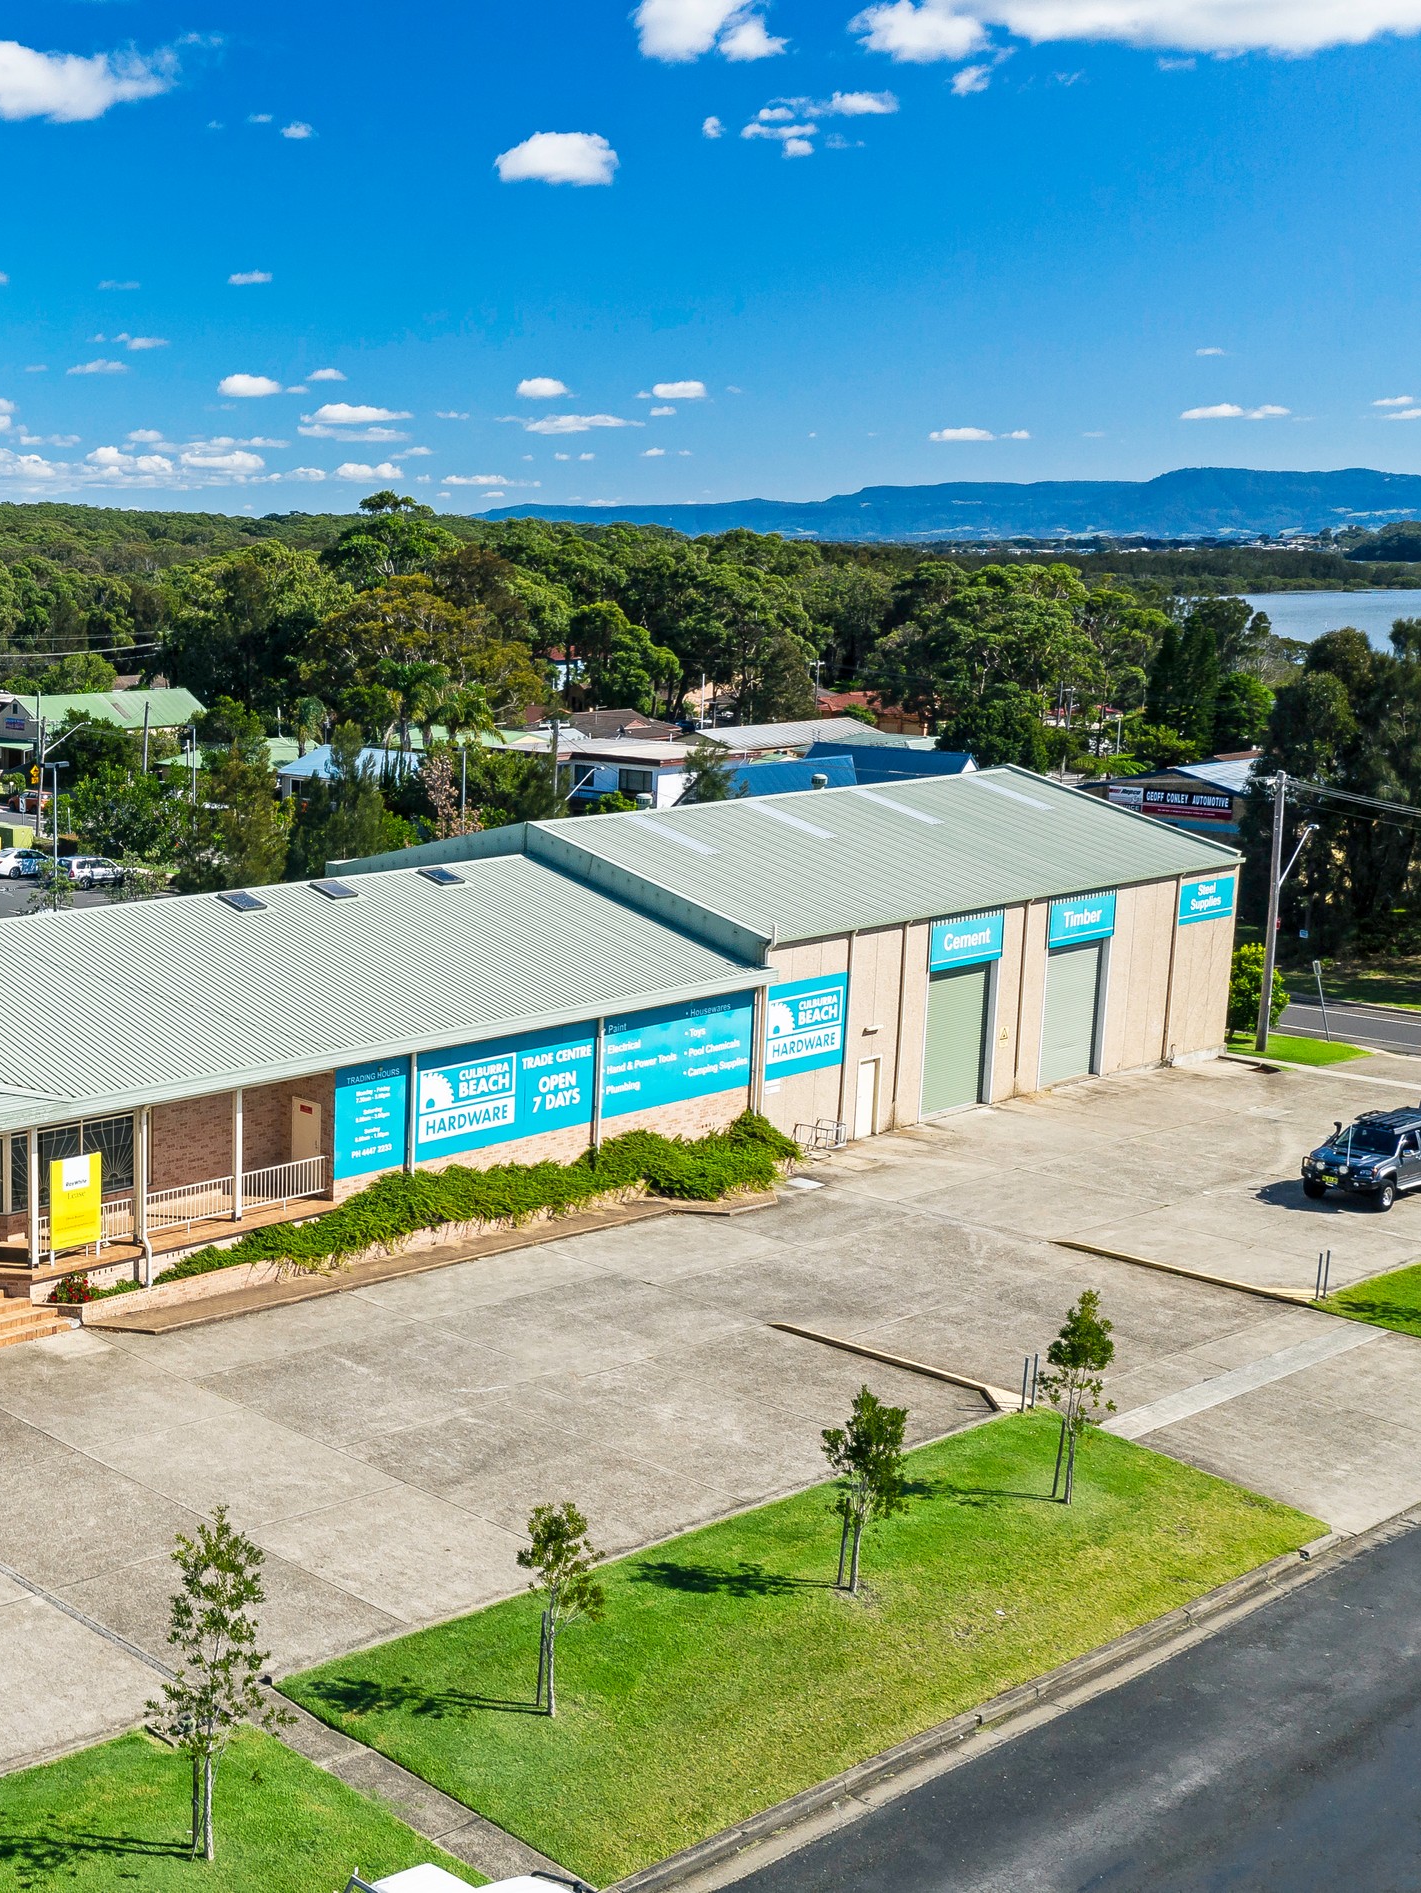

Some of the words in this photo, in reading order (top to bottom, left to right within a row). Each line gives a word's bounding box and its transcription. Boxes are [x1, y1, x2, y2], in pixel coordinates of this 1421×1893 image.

[1146, 791, 1164, 802] GEOFF
[1166, 793, 1188, 804] CONLEY
[1191, 794, 1229, 808] AUTOMOTIVE
[1198, 882, 1216, 896] Steel
[1190, 895, 1222, 911] Supplies
[1063, 908, 1102, 928] Timber
[943, 927, 991, 951] Cement
[690, 1003, 731, 1017] Housewares
[798, 994, 838, 1010] CULBURRA
[798, 1004, 838, 1026] BEACH
[608, 1023, 627, 1033] Paint
[689, 1028, 706, 1038] Toys
[607, 1039, 641, 1054] Electrical
[688, 1045, 704, 1057] Pool
[705, 1039, 740, 1054] Chemicals
[772, 1032, 836, 1058] HARDWARE
[522, 1054, 554, 1070] TRADE
[555, 1044, 592, 1062] CENTRE
[606, 1062, 626, 1075] Hand
[627, 1061, 633, 1071] &
[634, 1058, 658, 1069] Power
[658, 1052, 677, 1063] Tools
[347, 1073, 376, 1085] TRADING
[377, 1068, 400, 1078] HOURS
[458, 1061, 510, 1081] CULBURRA
[687, 1064, 718, 1077] Camping
[719, 1057, 748, 1070] Supplies
[458, 1072, 510, 1098] BEACH
[538, 1070, 577, 1093] OPEN
[606, 1081, 641, 1095] Plumbing
[532, 1096, 542, 1113] 7
[545, 1088, 581, 1111] DAYS
[426, 1104, 508, 1136] HARDWARE
[351, 1150, 361, 1158] PH
